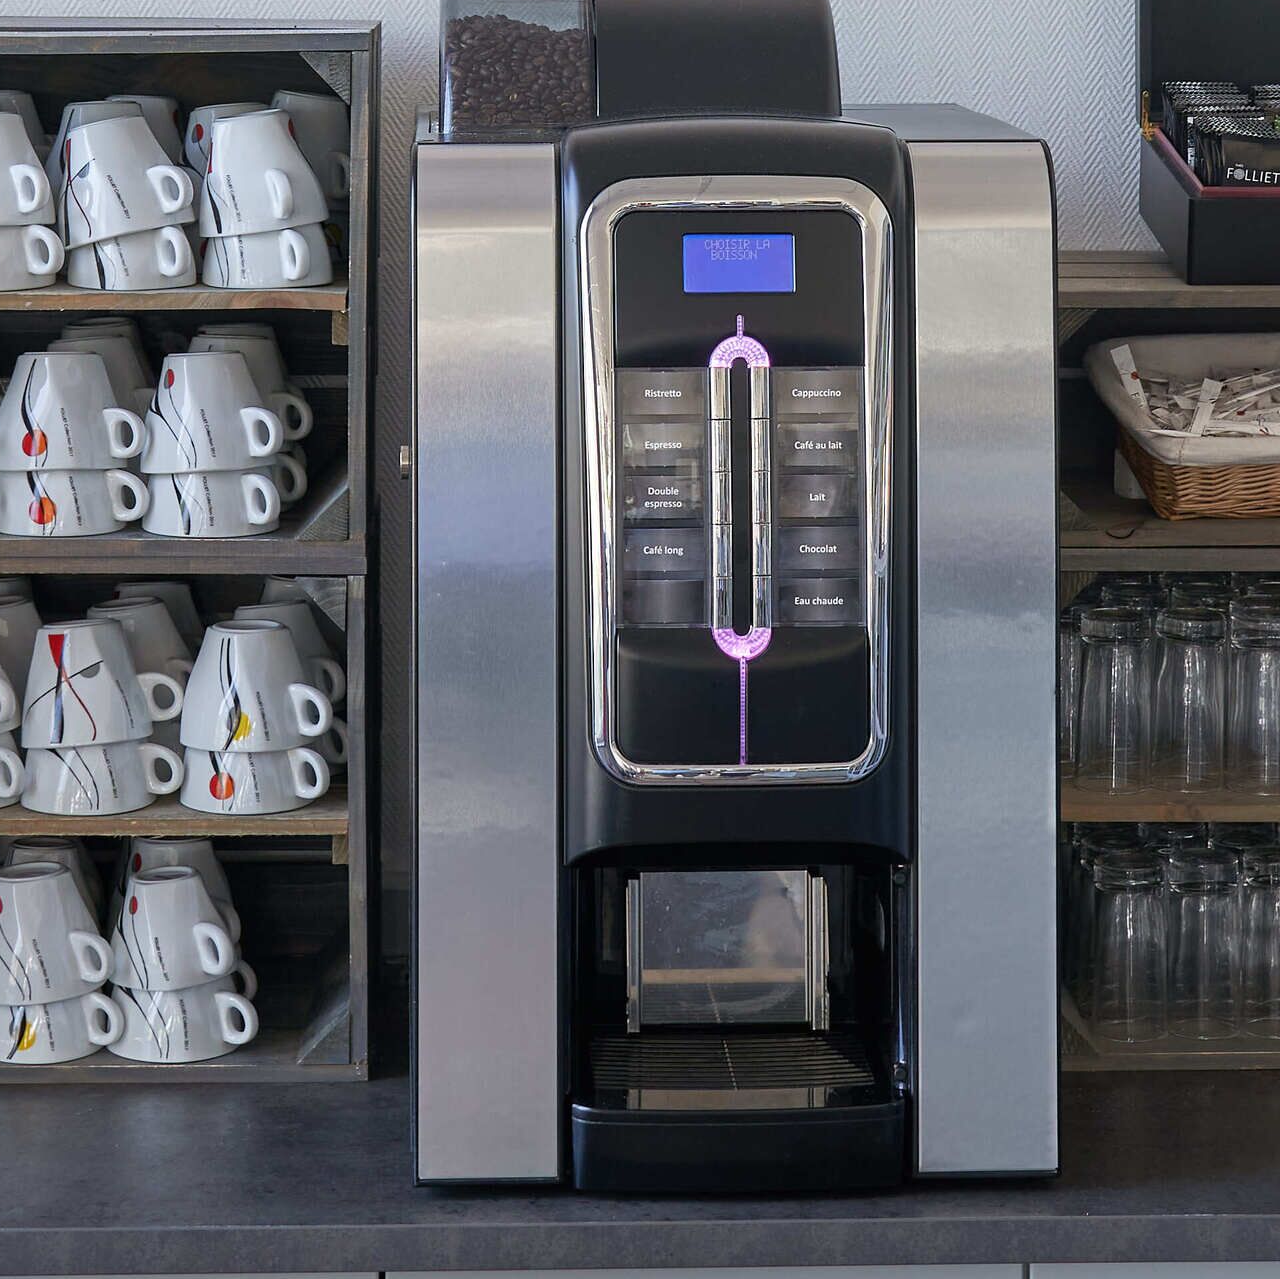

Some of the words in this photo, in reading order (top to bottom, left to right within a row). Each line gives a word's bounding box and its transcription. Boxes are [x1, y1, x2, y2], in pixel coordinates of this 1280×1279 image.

[1226, 167, 1280, 184] FOLLIET
[704, 239, 751, 250] CHOISIR
[756, 239, 770, 250] LA
[711, 249, 758, 261] BOISSON
[644, 389, 682, 398] Ristretto
[792, 388, 842, 398] Cappuccino
[644, 441, 682, 450] Espresso
[794, 440, 813, 450] Café
[828, 440, 842, 450] lait
[647, 486, 679, 496] Double
[809, 493, 826, 501] Lait
[644, 501, 683, 509] espresso
[643, 545, 663, 555] Café
[664, 545, 684, 557] long
[799, 544, 838, 553] Chocolat
[794, 596, 810, 605] Eau
[812, 596, 844, 605] chaude
